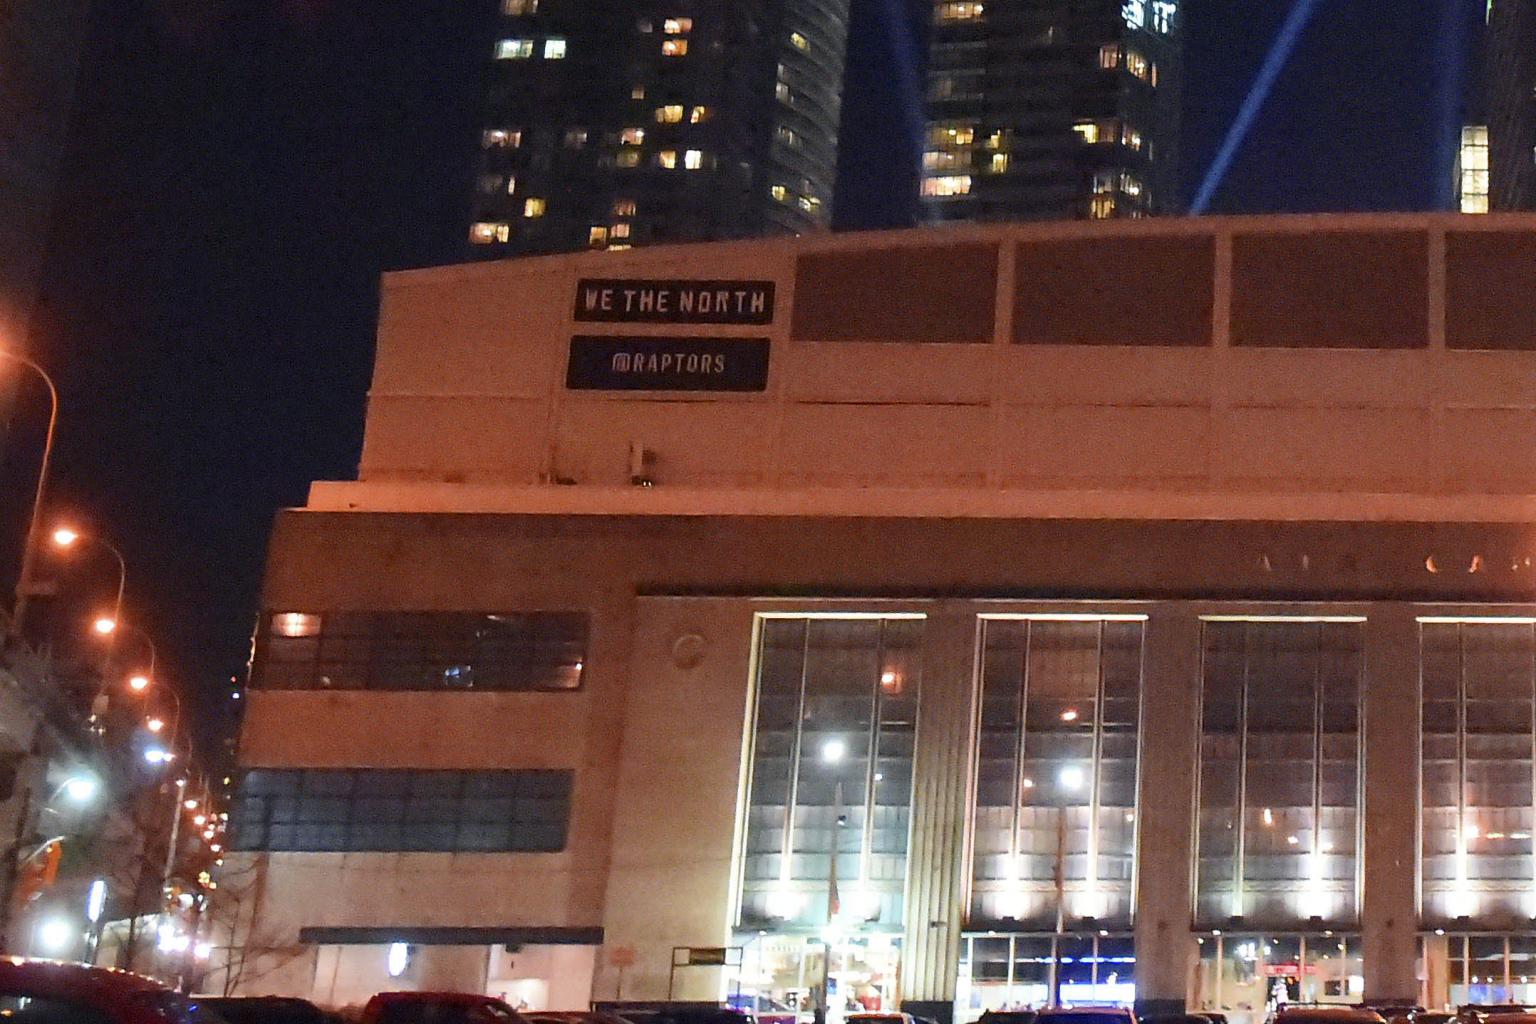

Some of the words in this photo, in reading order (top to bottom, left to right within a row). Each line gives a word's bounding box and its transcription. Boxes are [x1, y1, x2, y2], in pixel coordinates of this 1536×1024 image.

[585, 289, 613, 311] WE
[624, 290, 670, 313] THE
[679, 290, 765, 313] NORTH
[612, 352, 725, 374] @RAPTORS
